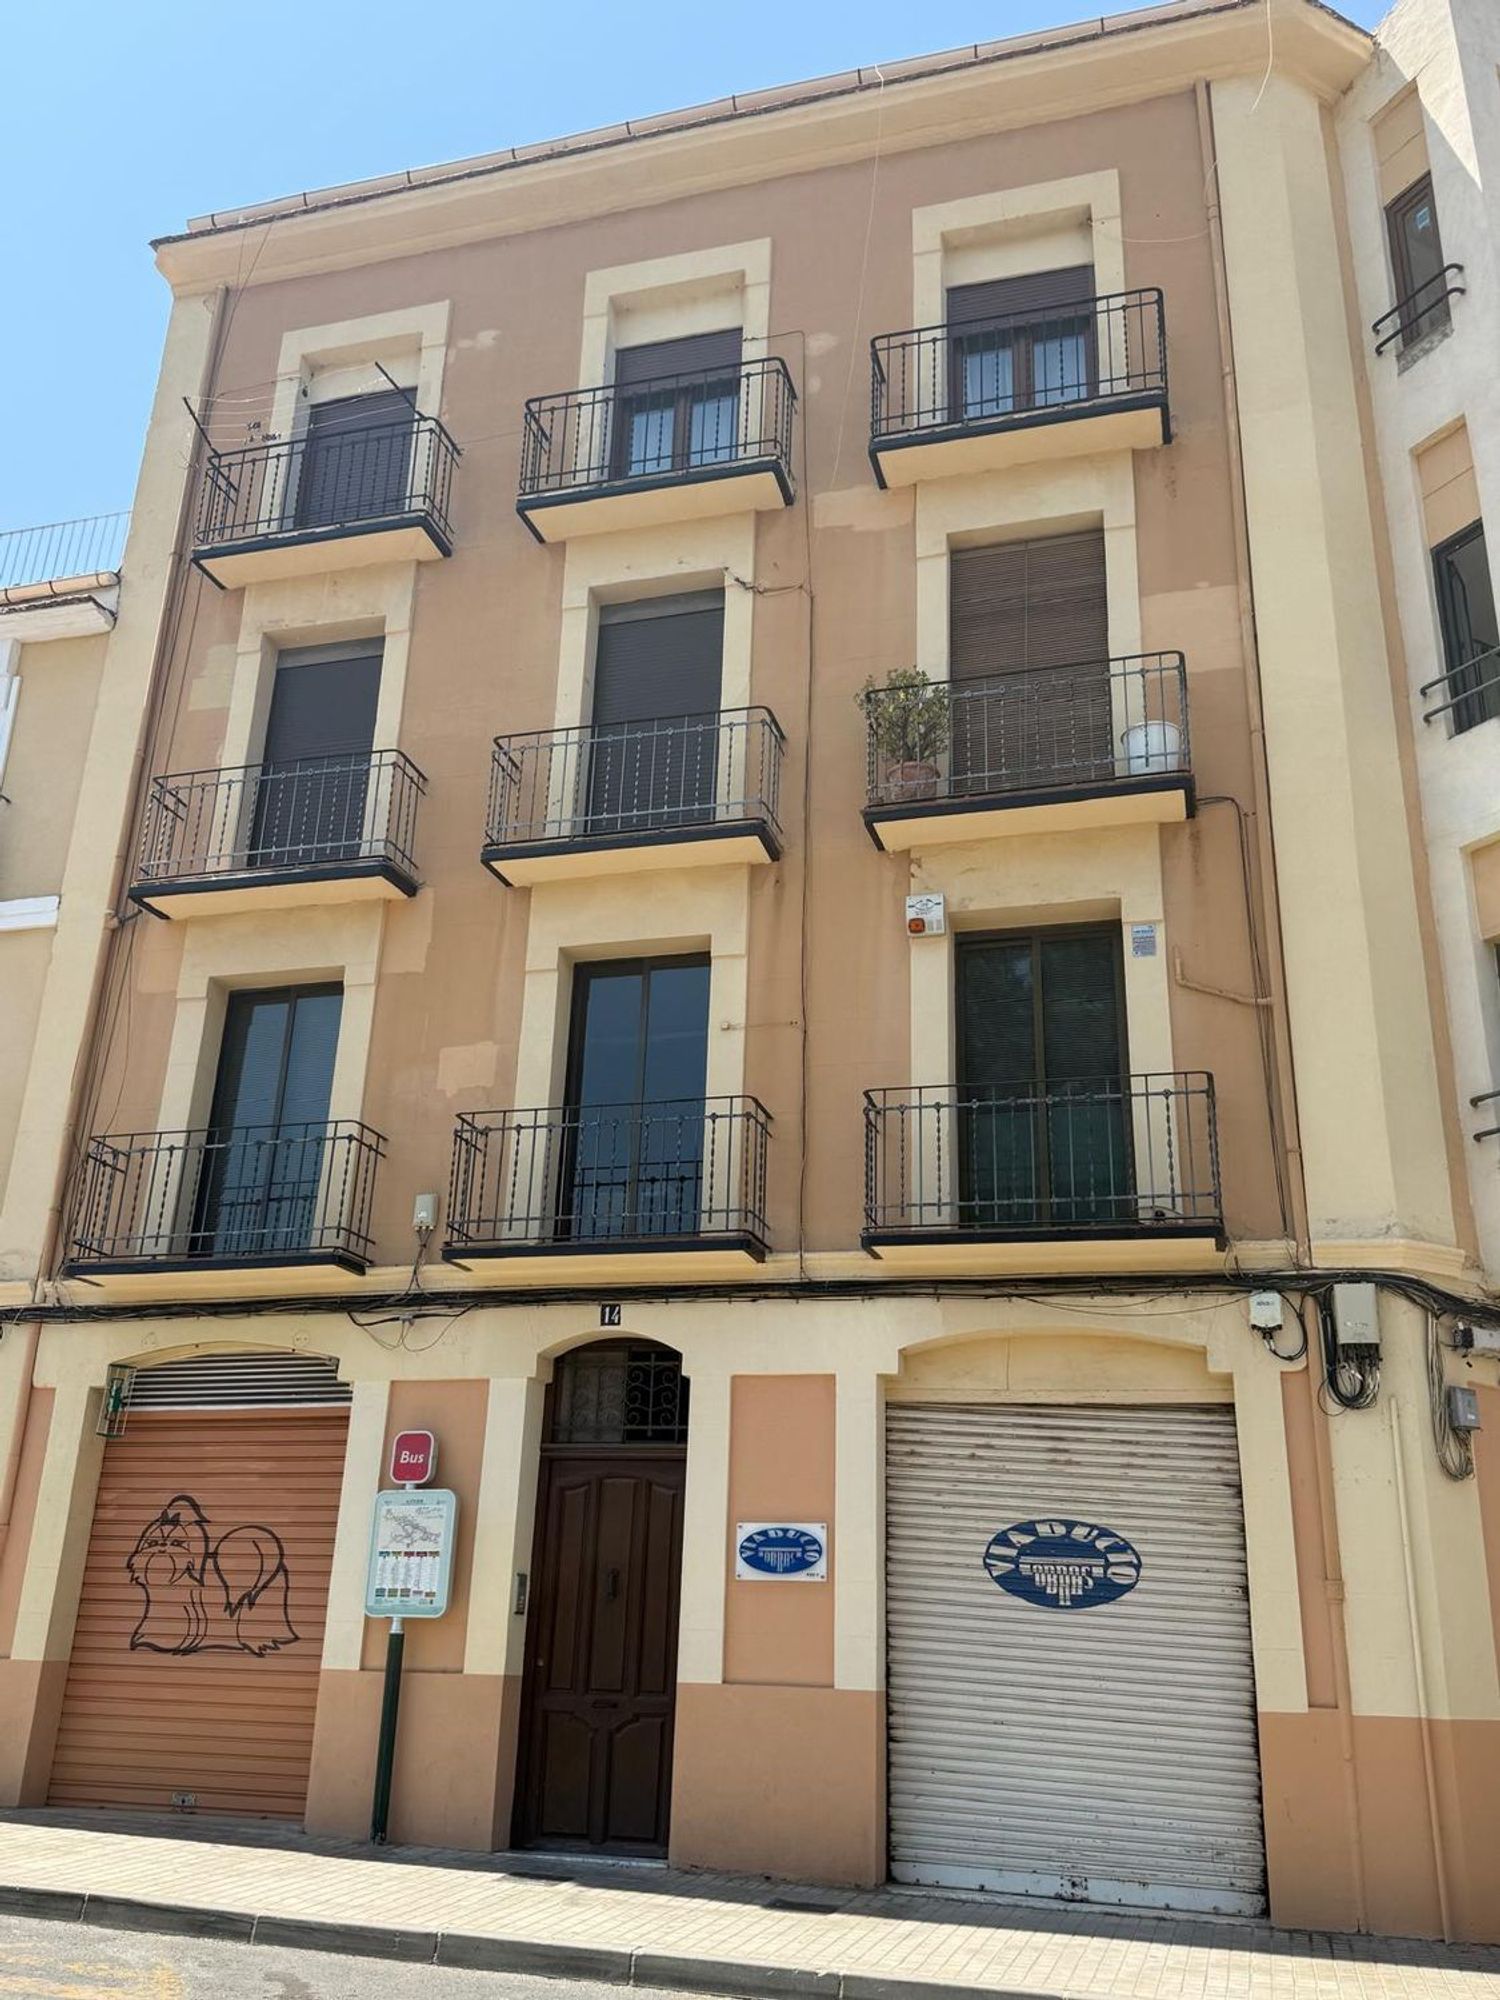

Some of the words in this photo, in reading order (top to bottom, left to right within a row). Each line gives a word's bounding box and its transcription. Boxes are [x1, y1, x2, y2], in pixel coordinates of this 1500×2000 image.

[604, 1305, 620, 1324] 14
[400, 1450, 424, 1464] Bus
[741, 1529, 820, 1562] VIADUCTO
